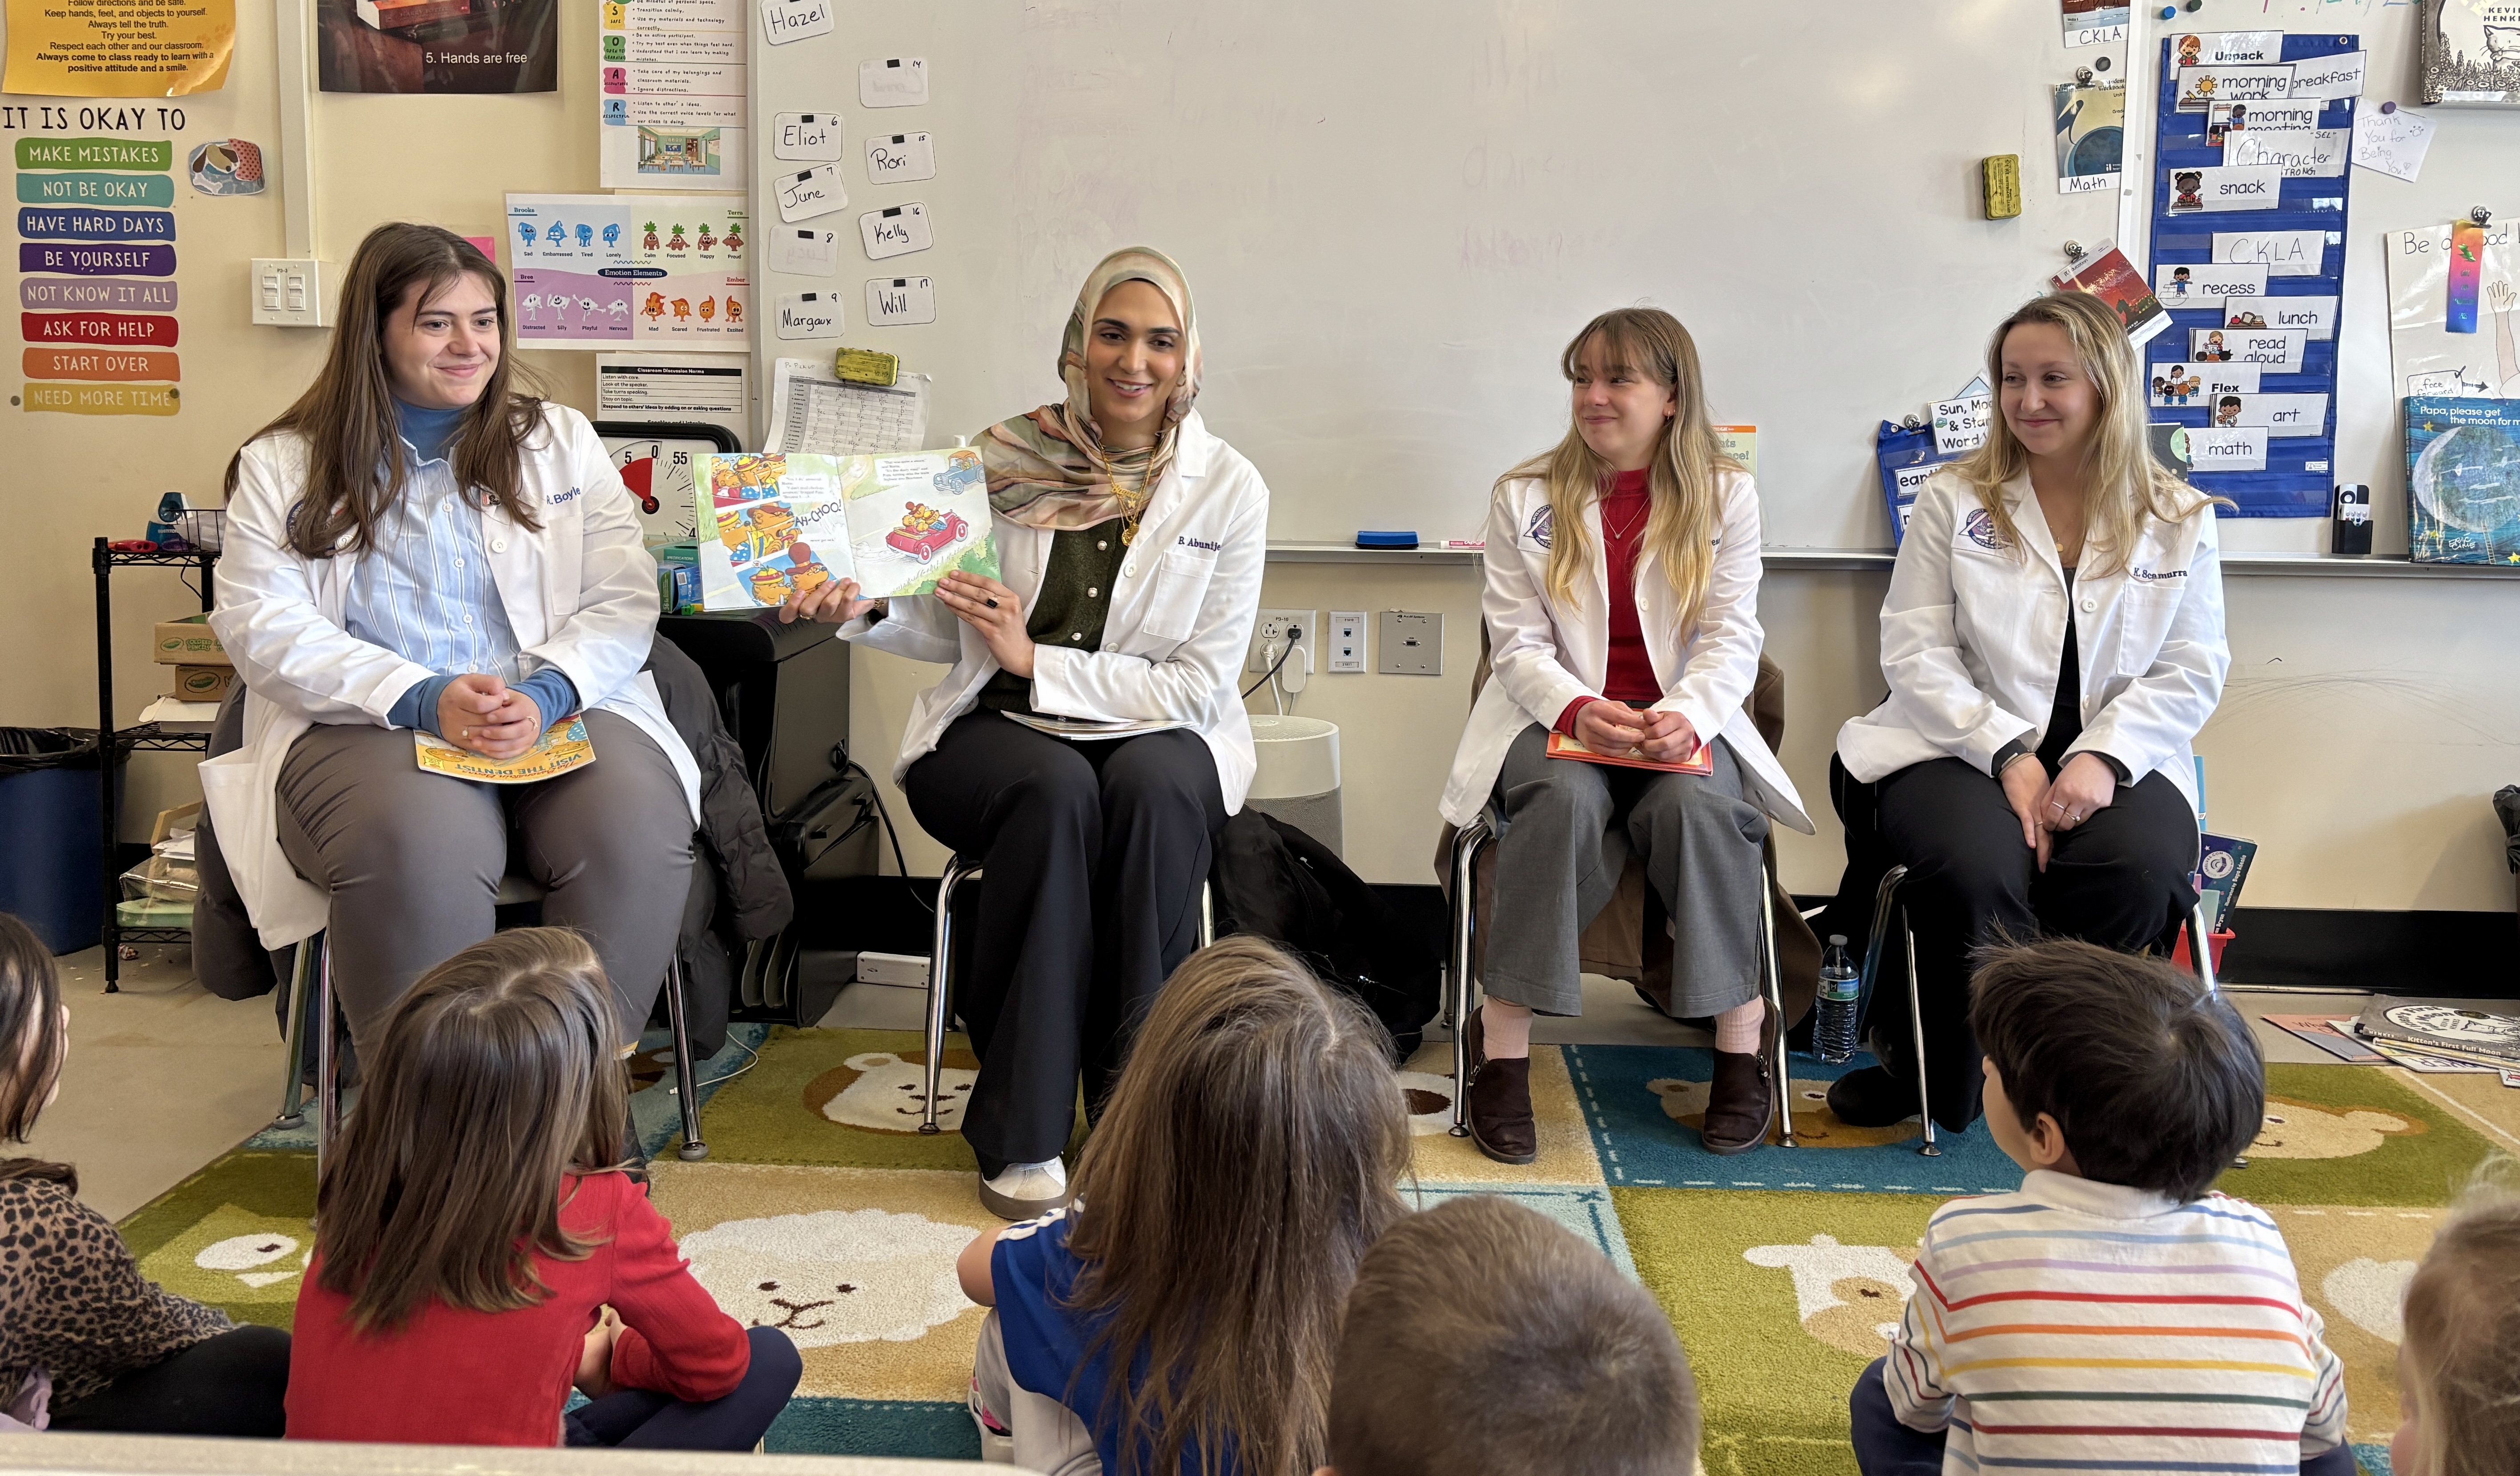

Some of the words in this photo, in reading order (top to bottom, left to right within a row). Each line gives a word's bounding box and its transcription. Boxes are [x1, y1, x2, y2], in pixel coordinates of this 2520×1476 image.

[44, 9, 67, 19] Keep
[68, 9, 96, 18] hands,
[98, 9, 117, 18] feet,
[118, 9, 134, 17] and
[136, 9, 165, 19] objects
[166, 9, 175, 17] to
[176, 7, 208, 18] yourself.
[771, 4, 826, 36] Hazel
[88, 20, 117, 30] Always
[119, 20, 132, 28] tell
[133, 20, 147, 28] the
[148, 20, 169, 28] truth.
[101, 31, 115, 41] Try
[116, 32, 136, 41] your
[137, 31, 157, 39] best.
[2078, 25, 2121, 45] CKLA
[50, 42, 84, 52] Respect
[85, 42, 106, 50] each
[108, 42, 130, 50] other
[131, 42, 147, 50] and
[164, 41, 204, 50] classroom.
[36, 52, 69, 63] Always
[109, 53, 132, 61] class
[134, 53, 159, 63] ready
[171, 52, 190, 61] learn
[192, 51, 208, 60] with
[426, 52, 437, 64] 5.
[441, 52, 480, 64] Hands
[483, 55, 502, 64] are
[505, 52, 527, 63] free
[2215, 50, 2264, 63] Unpack
[68, 64, 103, 73] positive
[105, 64, 138, 72] attitude
[140, 64, 157, 72] and
[166, 63, 189, 72] smile.
[913, 60, 921, 69] 14
[2222, 75, 2287, 91] morning
[2230, 89, 2271, 100] work
[2, 106, 28, 129] IT
[40, 107, 68, 129] IS
[80, 107, 145, 130] OKAY
[157, 108, 185, 131] TO
[831, 116, 837, 126] 6
[2249, 108, 2313, 124] morning
[2357, 115, 2402, 128] Thank
[784, 126, 826, 145] Eliot
[2365, 131, 2385, 144] You
[2390, 131, 2406, 142] for
[29, 146, 72, 161] MAKE
[78, 146, 159, 163] MISTAKES
[2236, 138, 2331, 166] Character
[2359, 146, 2391, 160] Being
[871, 149, 906, 171] Rori
[826, 166, 833, 175] 7
[2282, 168, 2315, 176] TRONG
[43, 181, 72, 197] NOT
[79, 181, 98, 197] BE
[105, 181, 148, 198] OKAY
[2069, 177, 2106, 193] Math
[2219, 179, 2266, 195] snack
[784, 184, 825, 208] June
[913, 207, 920, 215] 16
[27, 216, 66, 231] HAVE
[73, 216, 116, 232] HARD
[123, 217, 164, 233] DAYS
[826, 233, 833, 243] 8
[874, 223, 909, 244] Kelly
[2230, 237, 2304, 264] CKLA
[2403, 232, 2430, 255] Be
[45, 251, 64, 266] BE
[70, 251, 150, 267] YOURSELF
[920, 278, 928, 289] 17
[2202, 283, 2255, 295] recess
[28, 286, 56, 301] NOT
[63, 286, 110, 302] KNOW
[117, 287, 136, 302] IT
[143, 287, 170, 303] ALL
[831, 293, 837, 303] 9
[879, 290, 906, 315] Will
[783, 308, 831, 331] Margaux
[2278, 310, 2318, 325] lunch
[44, 321, 73, 336] ASK
[80, 321, 111, 336] FOR
[118, 322, 154, 337] HELP
[2249, 335, 2286, 350] read
[53, 355, 99, 371] START
[106, 356, 149, 372] OVER
[2243, 350, 2286, 363] aloud
[2211, 383, 2239, 393] Flex
[2423, 378, 2444, 390] face
[34, 390, 72, 405] NEED
[80, 391, 124, 406] MORE
[130, 388, 171, 407] TIME
[2416, 387, 2454, 396] forward
[1939, 404, 1967, 415] Sun,
[2273, 408, 2301, 422] art
[2420, 405, 2449, 416] Papa,
[2450, 407, 2483, 417] please
[2484, 408, 2501, 417] get
[1949, 420, 1959, 432] &
[2450, 415, 2467, 424] the
[2497, 417, 2512, 426] for
[1942, 434, 1980, 452] Word
[2209, 441, 2252, 456] math
[624, 451, 632, 465] 5
[651, 445, 659, 458] 0
[673, 451, 688, 465] 55
[553, 486, 581, 504] Boyle
[795, 499, 842, 526] AH-CHOO!
[2133, 567, 2141, 577] K.
[2142, 569, 2188, 580] Scamurra
[550, 754, 582, 769] VISIT
[455, 763, 513, 775] DENTIST
[517, 765, 546, 774] THE
[2368, 1030, 2395, 1038] HENKES
[2407, 1036, 2439, 1046] Kitten's
[2441, 1042, 2460, 1050] First
[2462, 1044, 2476, 1053] Full
[2479, 1048, 2501, 1056] Moon
